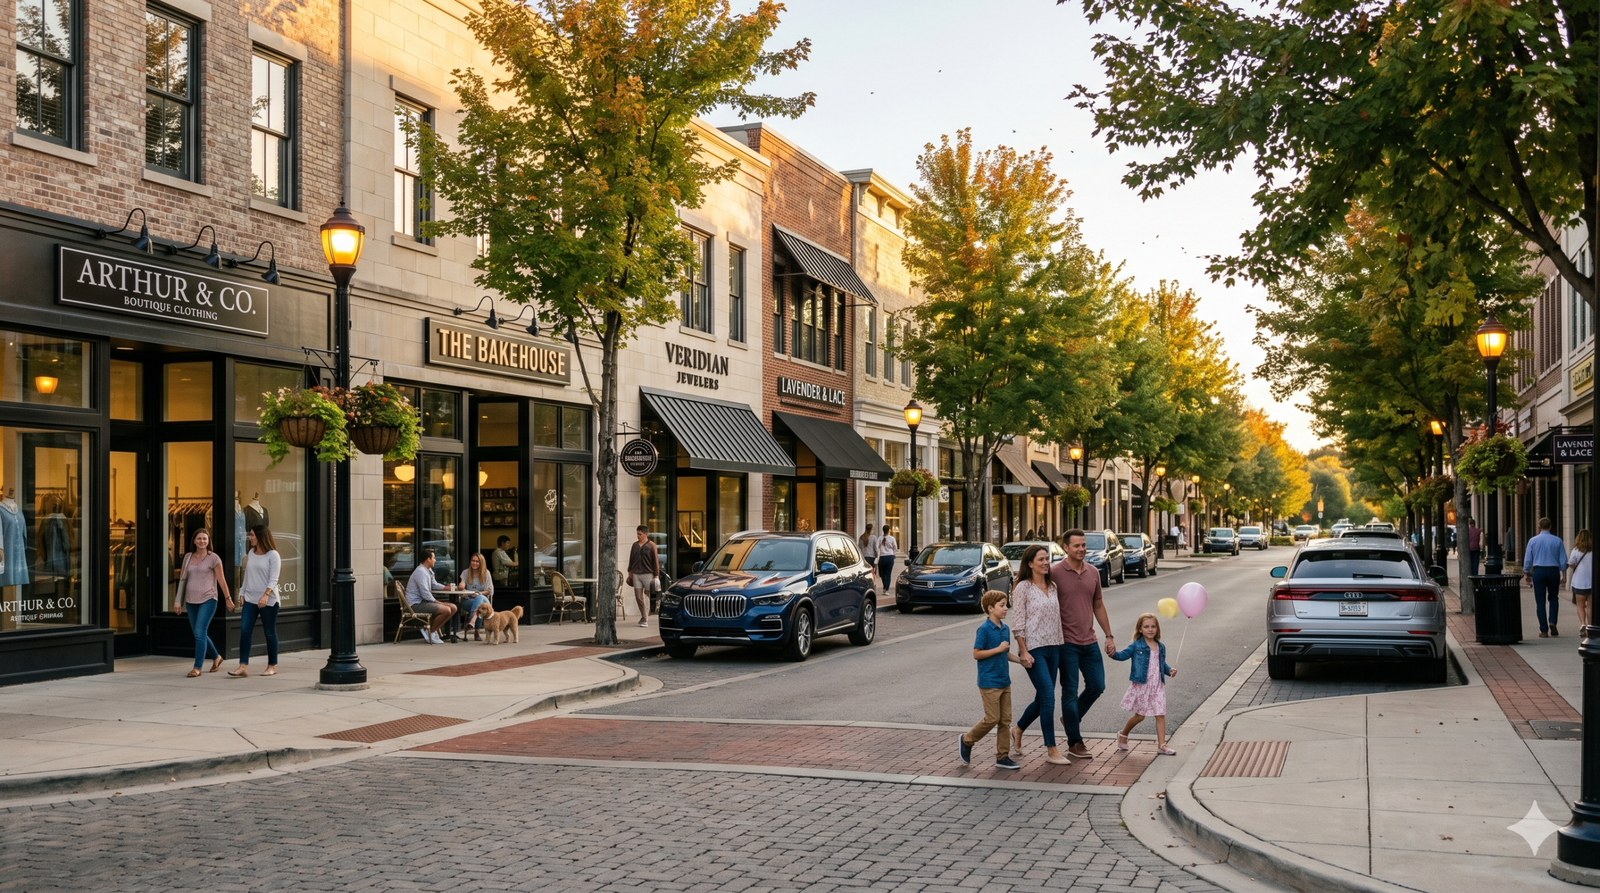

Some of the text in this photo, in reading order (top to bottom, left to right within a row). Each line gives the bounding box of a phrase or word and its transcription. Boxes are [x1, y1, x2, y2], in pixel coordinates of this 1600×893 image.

[77, 258, 257, 315] ARTHUR & CO.
[124, 296, 218, 321] BOUTIQUE CLOTHING
[437, 328, 566, 376] THE BAKEHOUSE
[665, 341, 729, 376] VERIDIAN
[676, 371, 719, 390] JEWELERS
[781, 377, 846, 406] LAVENDER & LACE
[1560, 449, 1593, 457] & LACE
[283, 582, 298, 593] CO.
[46, 598, 55, 609] &
[57, 597, 77, 609] CO.
